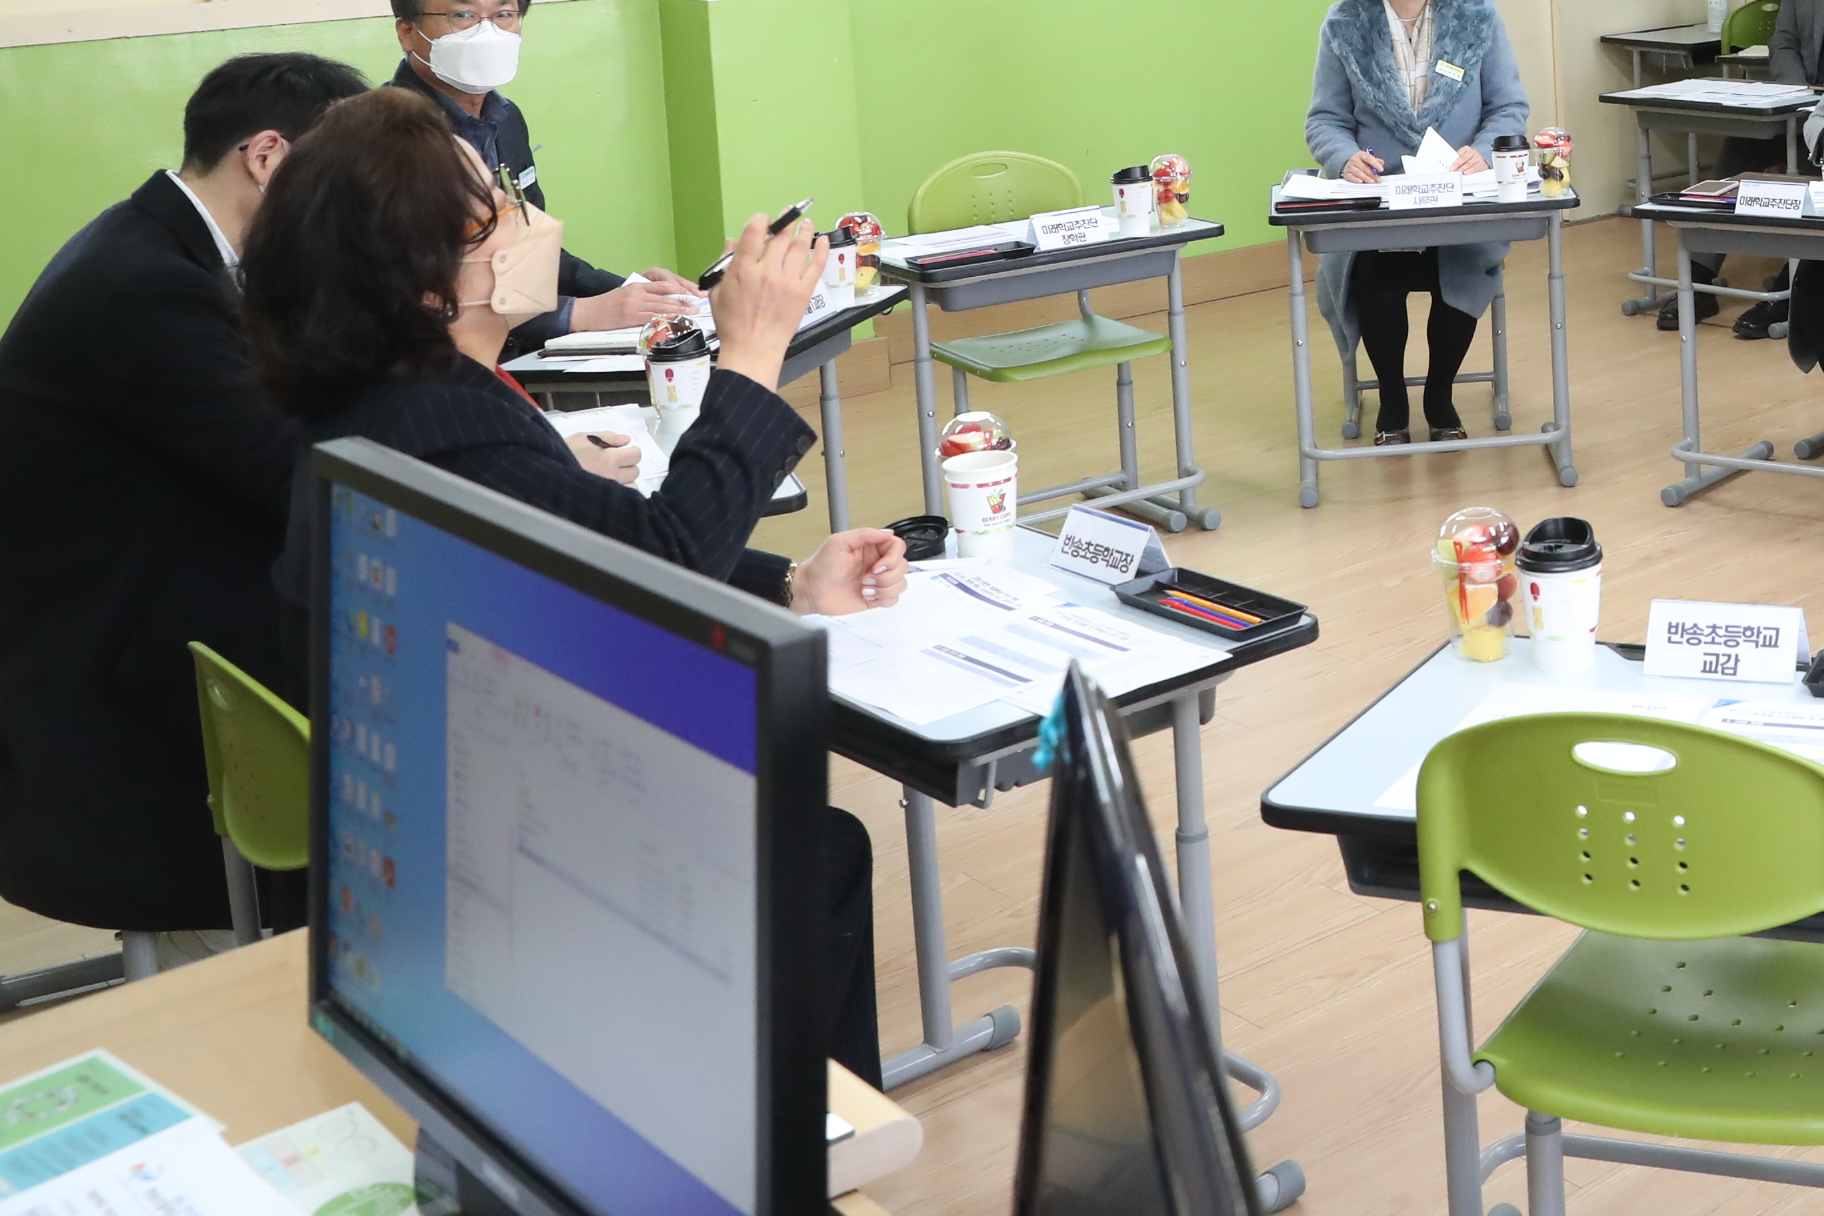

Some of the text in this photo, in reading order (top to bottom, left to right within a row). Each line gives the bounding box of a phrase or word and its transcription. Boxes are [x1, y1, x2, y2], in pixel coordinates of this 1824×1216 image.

[1395, 183, 1455, 195] 미래학교추진단
[1413, 195, 1439, 206] 사무관
[1740, 196, 1802, 210] 미래학교추진단장
[1041, 217, 1099, 234] 미래학교추진단
[1061, 533, 1135, 574] 반송초등학교장
[1667, 621, 1781, 649] 반송초등학교
[1700, 652, 1741, 676] 교감
